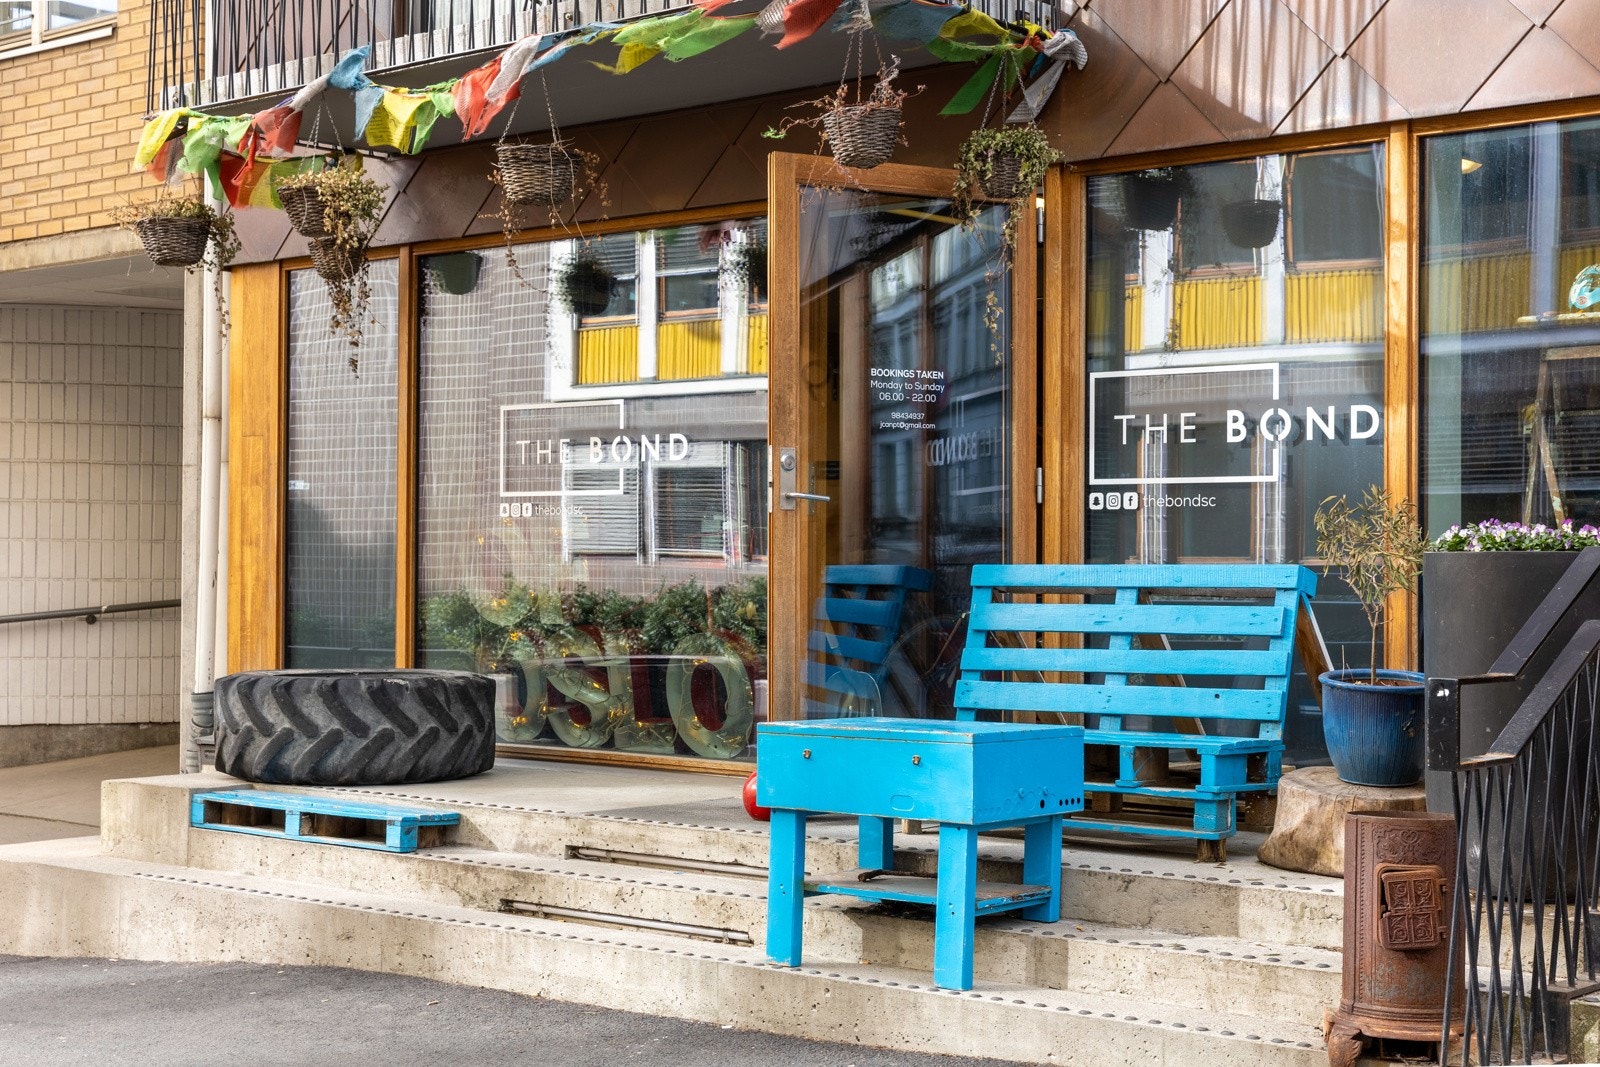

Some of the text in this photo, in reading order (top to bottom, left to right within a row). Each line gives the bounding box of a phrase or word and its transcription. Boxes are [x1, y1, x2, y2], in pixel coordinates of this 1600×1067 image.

[870, 368, 944, 379] BOOKINGS TAKEN
[870, 380, 945, 393] Monday to Sunday
[879, 392, 904, 401] 06.00
[1113, 404, 1380, 445] THE BOND
[516, 432, 689, 465] THE BOND
[1142, 493, 1217, 507] thebondsc
[534, 504, 584, 516] thebodsc
